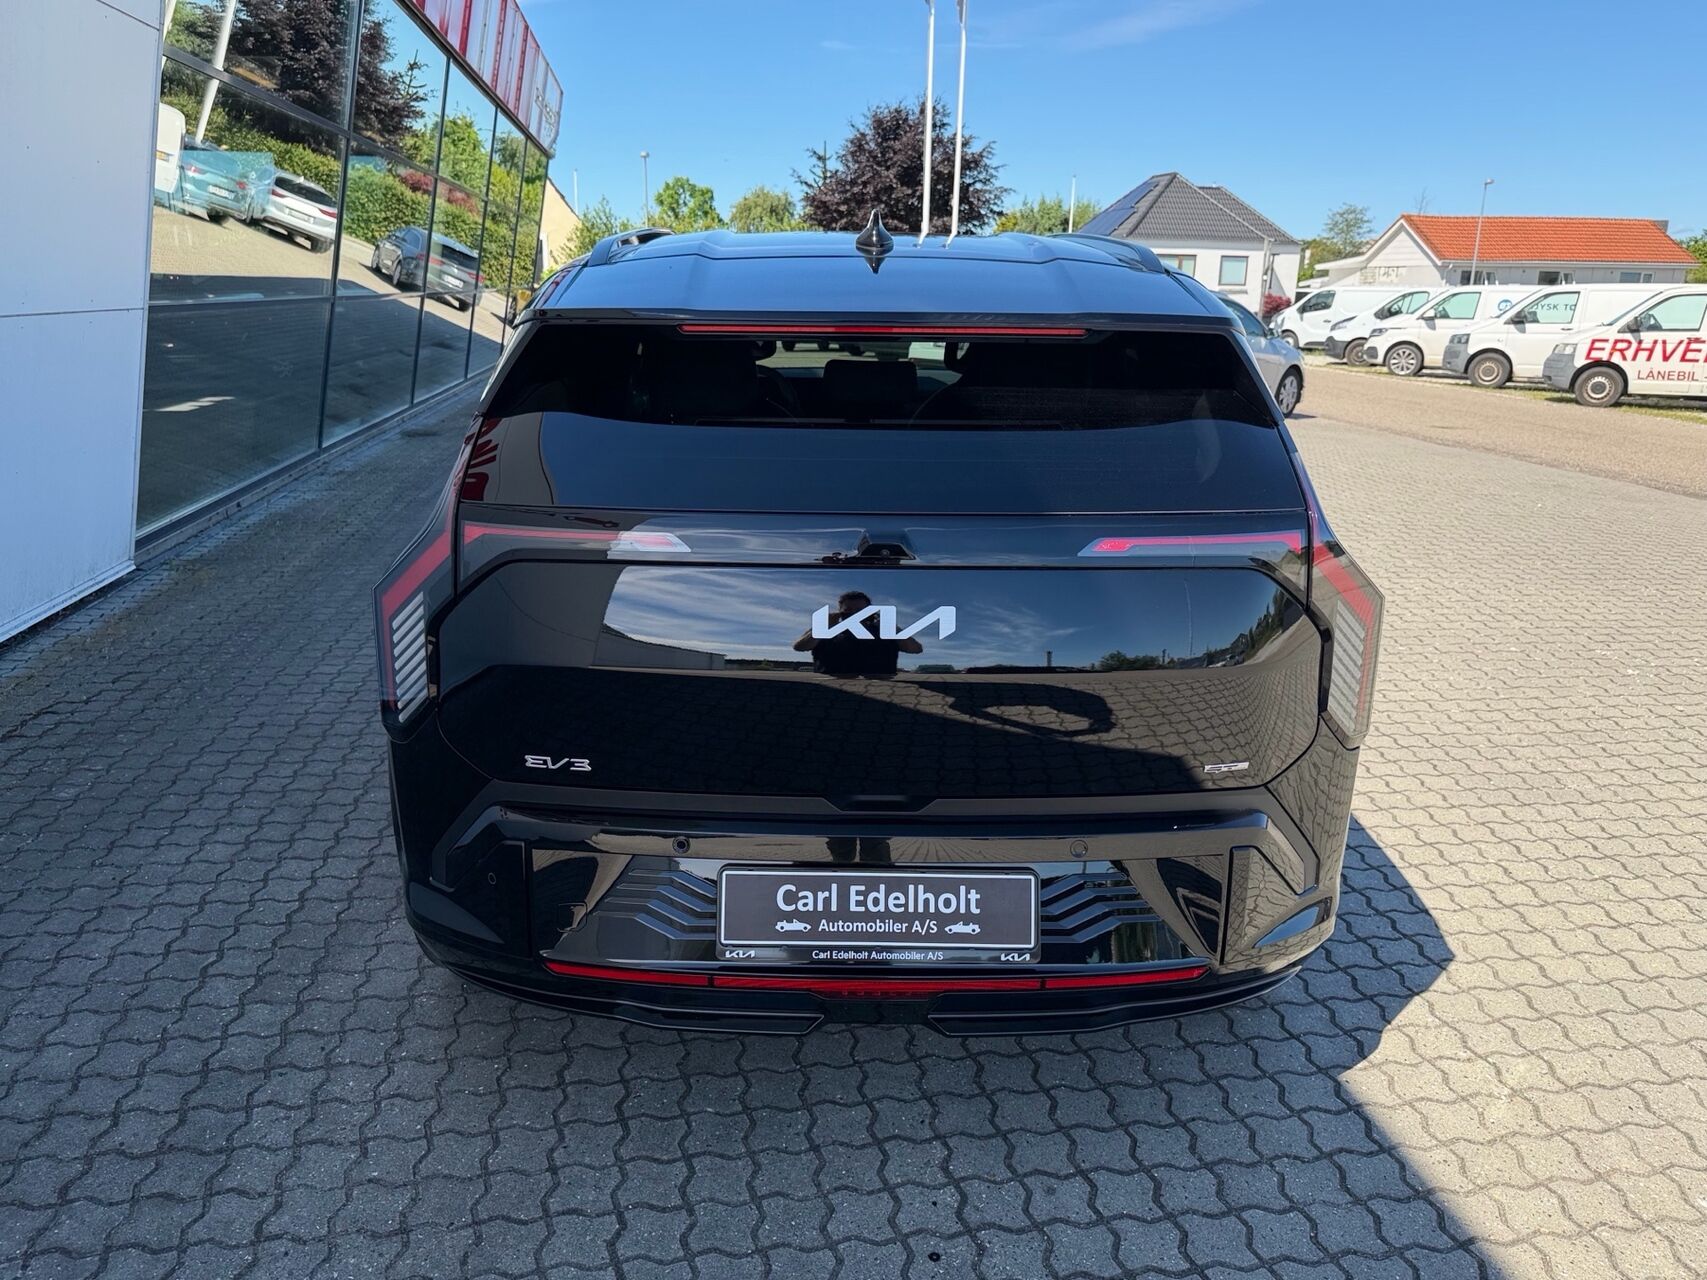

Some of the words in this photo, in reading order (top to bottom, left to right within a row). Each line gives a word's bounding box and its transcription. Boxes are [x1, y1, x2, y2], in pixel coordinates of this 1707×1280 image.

[1584, 338, 1707, 363] ERHVE
[1637, 368, 1699, 381] LÅNEBIL
[812, 604, 956, 640] KIA
[524, 754, 592, 772] EV3
[775, 883, 838, 912] Carl
[849, 884, 981, 914] Edelholt
[818, 919, 909, 934] Automobiler
[911, 920, 938, 935] A/S
[812, 950, 831, 959] Carl
[832, 950, 869, 959] Edelholt
[870, 951, 926, 960] Automobiler
[927, 951, 944, 961] A/S
